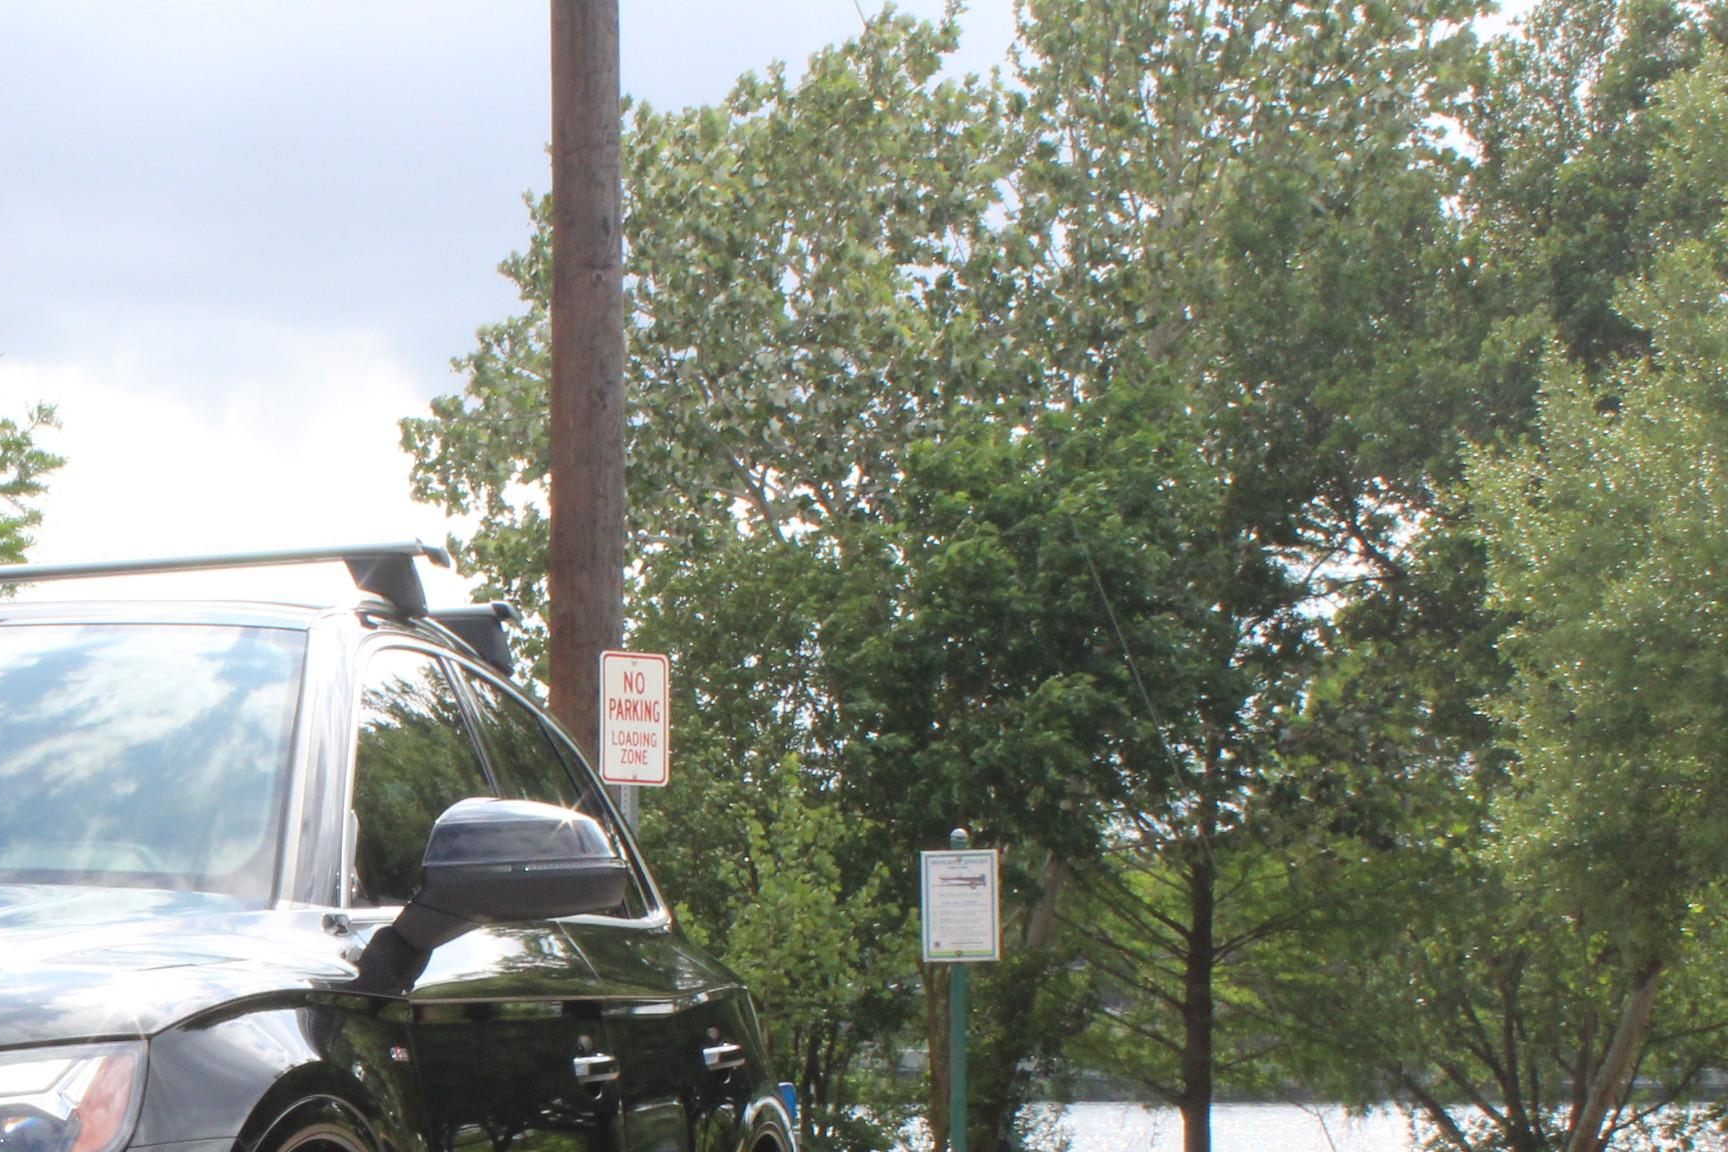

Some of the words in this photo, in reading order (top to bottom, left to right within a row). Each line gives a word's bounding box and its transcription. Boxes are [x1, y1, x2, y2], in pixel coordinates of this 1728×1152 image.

[623, 671, 645, 694] NO
[609, 698, 660, 723] PARKING
[611, 730, 657, 748] LOADING
[620, 748, 648, 765] ZONE
